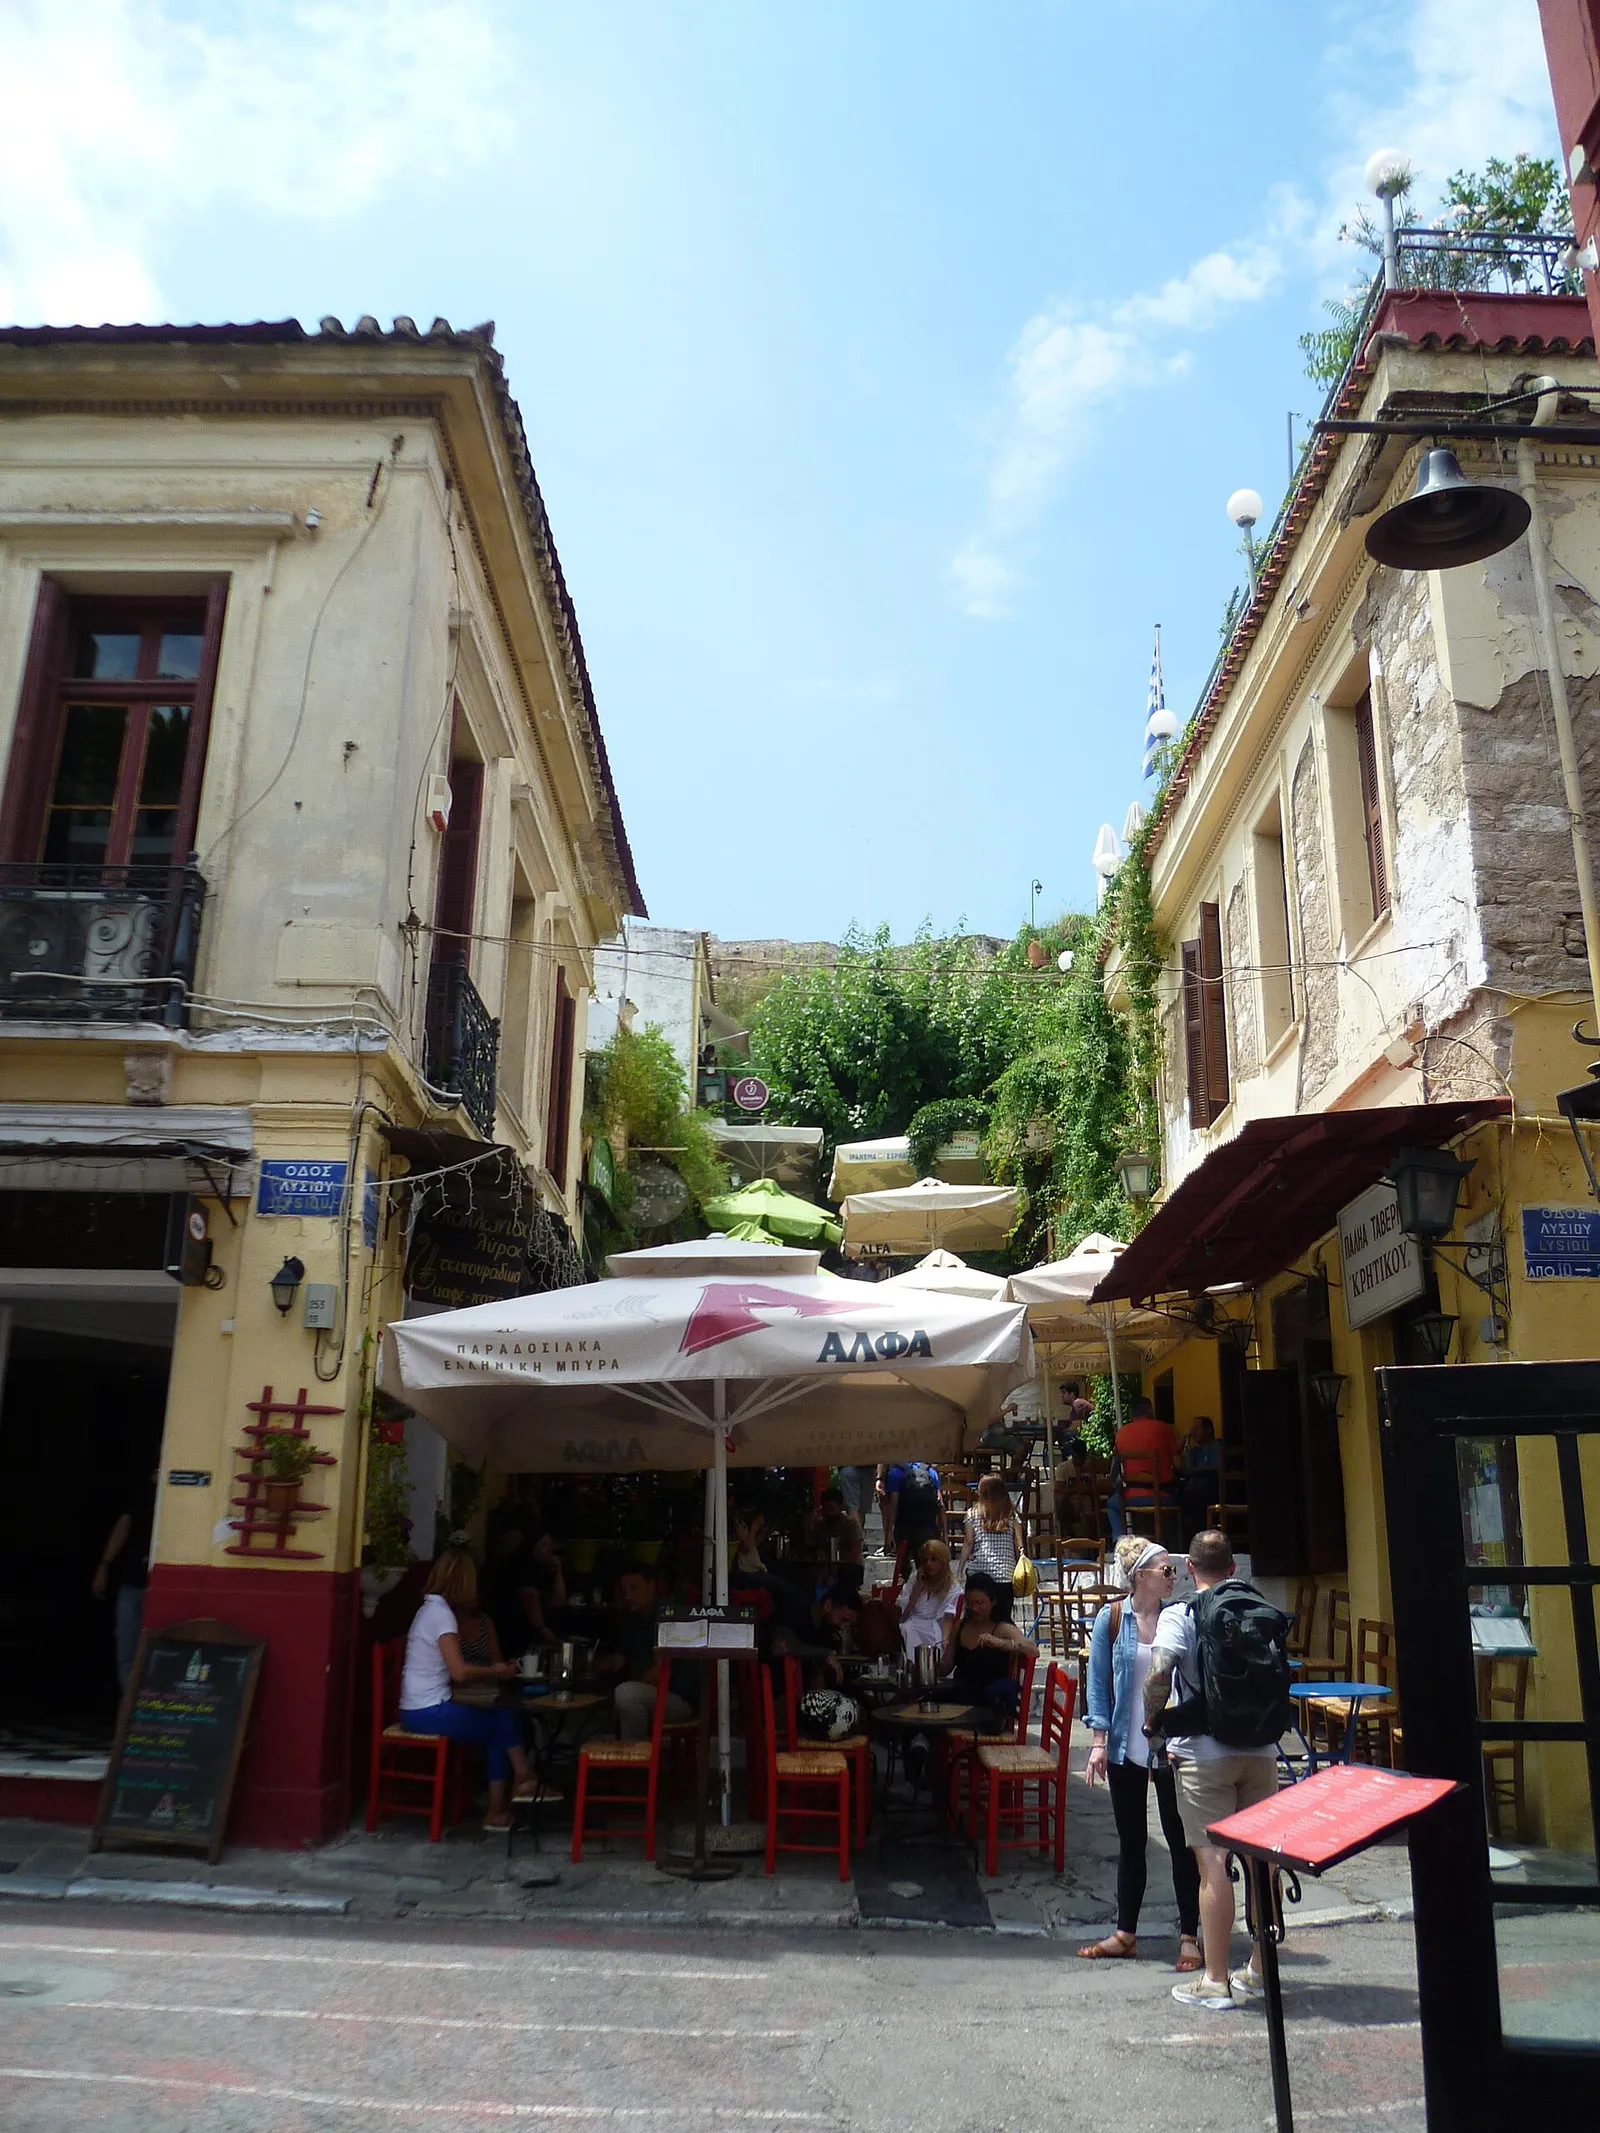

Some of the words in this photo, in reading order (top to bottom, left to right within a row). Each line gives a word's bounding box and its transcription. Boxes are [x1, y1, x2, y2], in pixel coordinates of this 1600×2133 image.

[285, 1165, 333, 1177] ΟΔΟΣ
[280, 1181, 334, 1193] ΛΥΣΙΟΥ
[1370, 1200, 1401, 1242] ΤΑΒΕΡΝ
[1540, 1223, 1591, 1235] ΛΥΣΙΟΥ
[859, 1242, 891, 1255] ALFA
[1540, 1240, 1590, 1252] LYSIOU
[1528, 1265, 1556, 1277] ΑΠΟ
[457, 1341, 602, 1355] ΠΑΡΑΔΟΣΙΑΚΑ
[816, 1329, 934, 1363] ΑΛΦΑ
[444, 1360, 541, 1372] ΕΛΛΗΝΙΚΗ
[556, 1358, 619, 1372] ΜΠΥΡΑ
